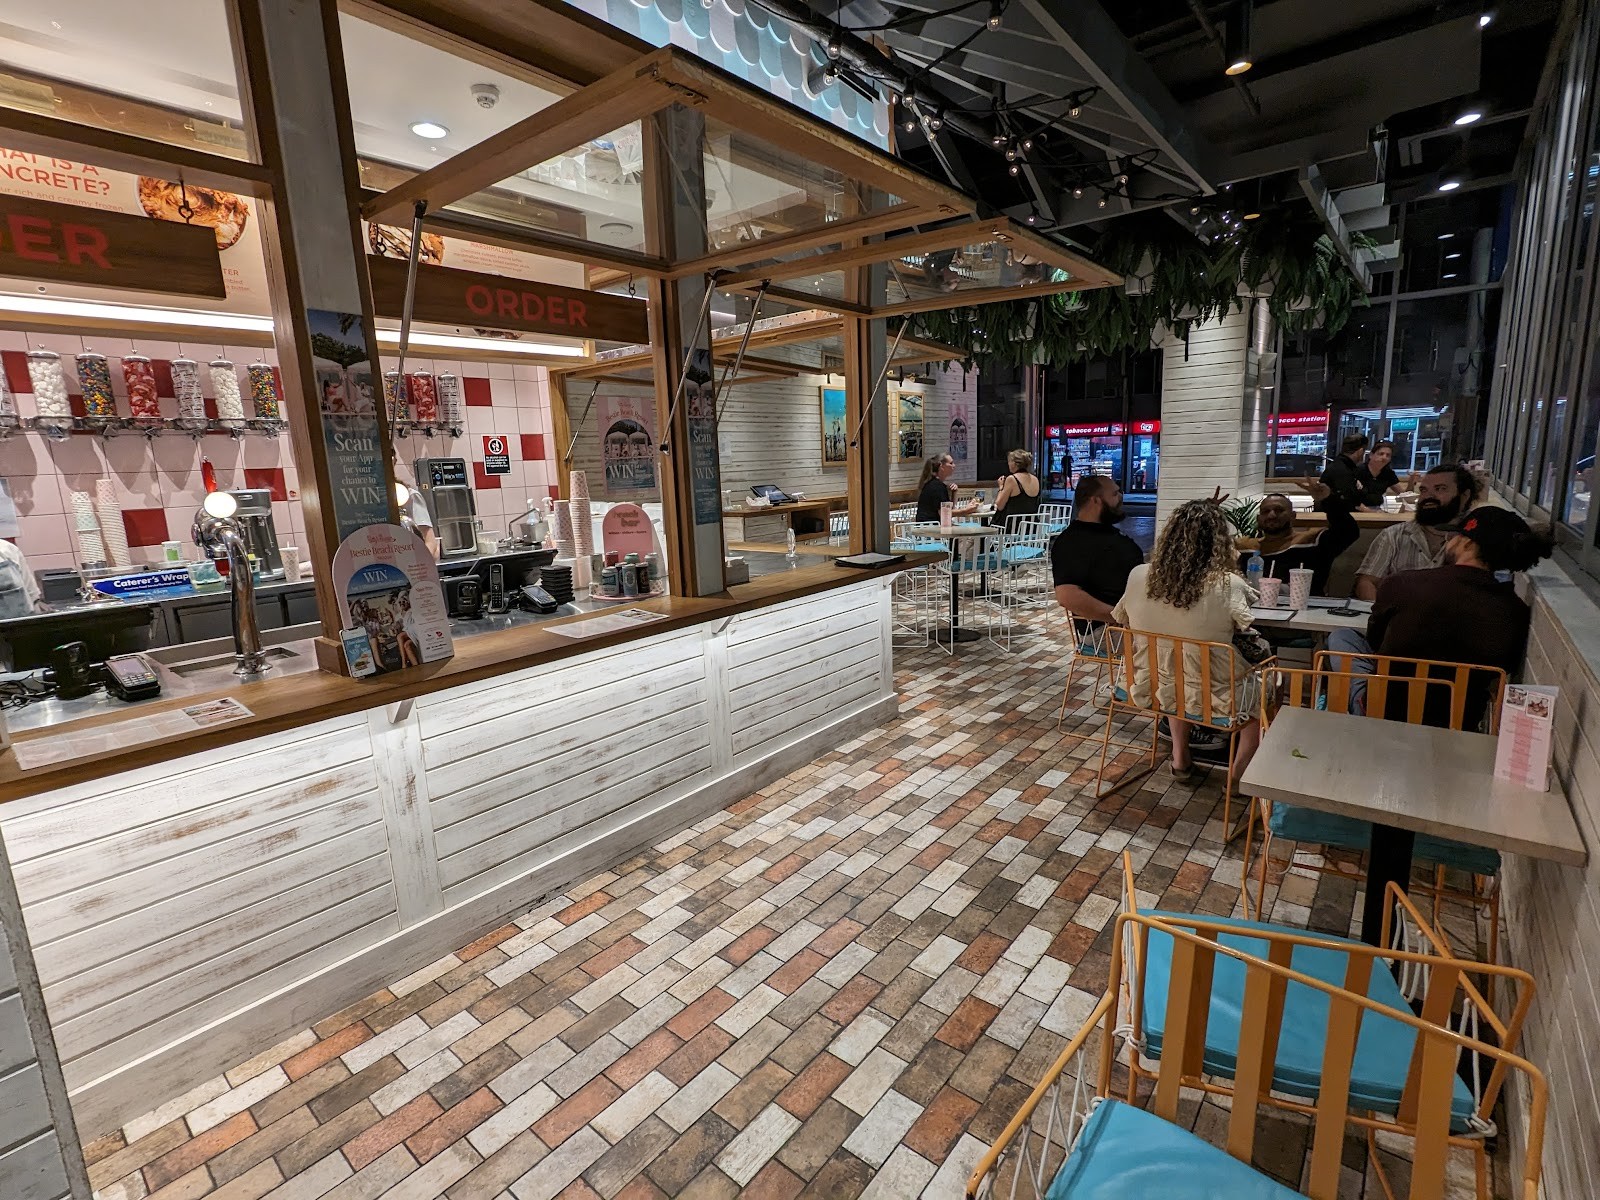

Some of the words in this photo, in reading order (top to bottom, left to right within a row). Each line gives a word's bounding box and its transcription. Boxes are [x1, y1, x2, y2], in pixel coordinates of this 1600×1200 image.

[36, 191, 55, 201] and
[0, 213, 112, 270] ER
[465, 284, 588, 328] ORDER
[1298, 415, 1326, 423] station
[333, 433, 374, 452] Scan
[693, 430, 712, 443] Scan
[608, 463, 634, 479] WIN
[695, 467, 715, 480] WIN
[340, 486, 382, 505] WIN
[349, 547, 371, 559] Bestie
[372, 544, 394, 555] Beach
[394, 543, 416, 555] Resort
[113, 576, 160, 588] Caterer's
[161, 573, 189, 582] Wrap
[363, 569, 389, 583] WIN
